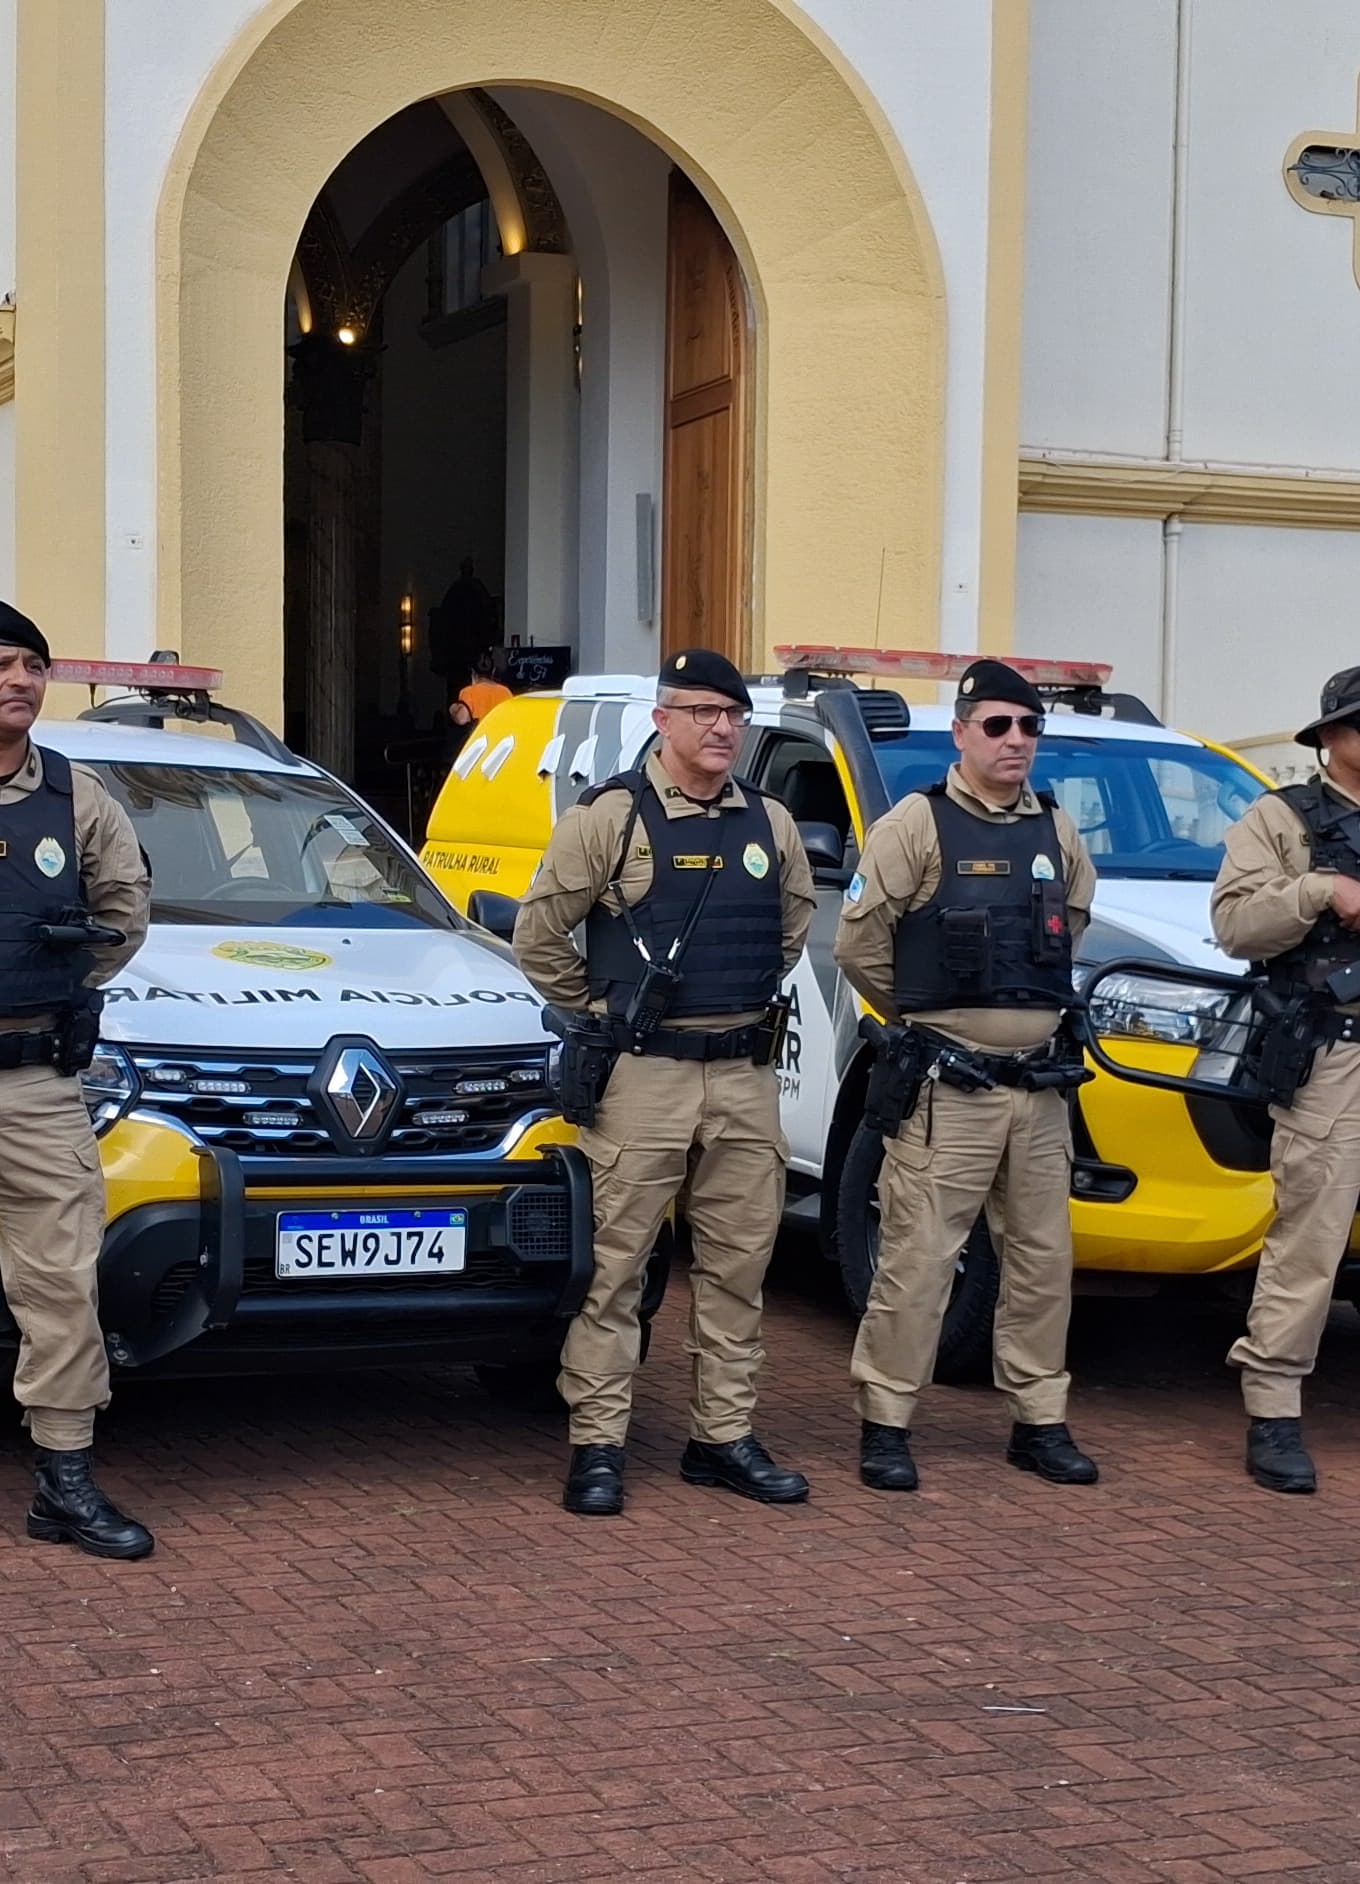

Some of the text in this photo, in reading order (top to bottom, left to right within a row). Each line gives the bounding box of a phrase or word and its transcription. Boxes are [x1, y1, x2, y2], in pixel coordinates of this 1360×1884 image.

[423, 850, 500, 875] PATRULHA RURAL
[359, 1214, 390, 1225] BRASIL
[295, 1231, 445, 1269] SEW9J74
